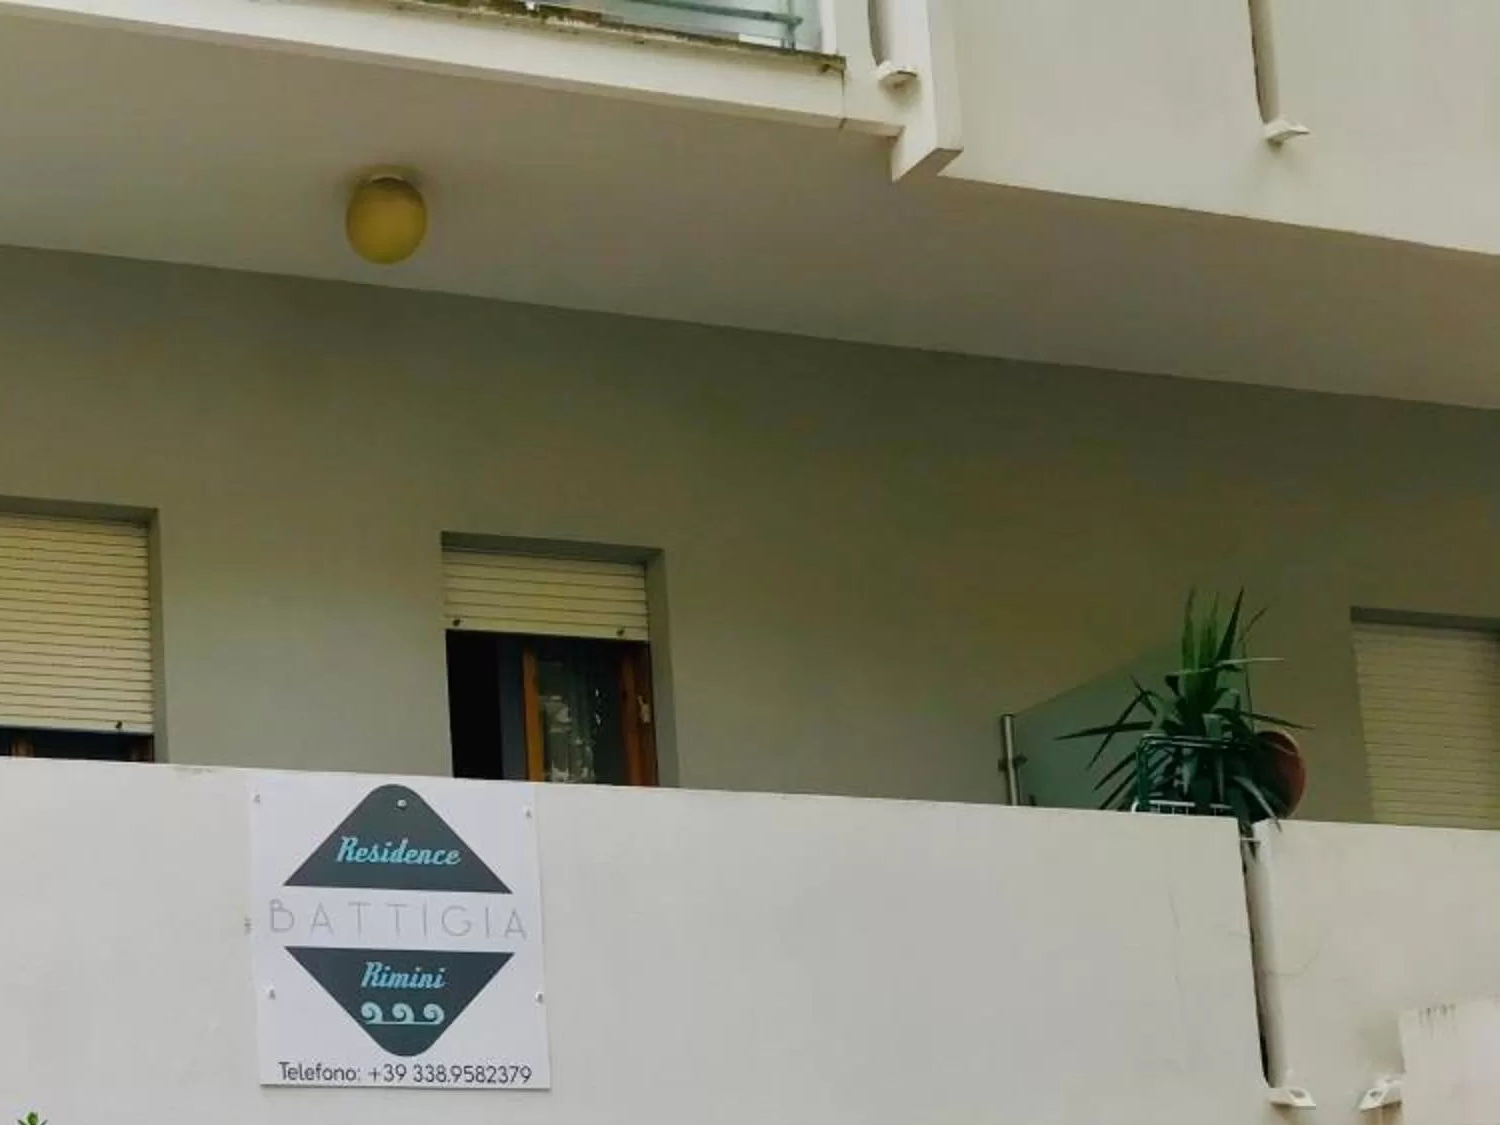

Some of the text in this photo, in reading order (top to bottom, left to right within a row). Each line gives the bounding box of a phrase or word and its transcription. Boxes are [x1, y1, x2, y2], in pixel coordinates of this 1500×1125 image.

[336, 836, 462, 865] Residence
[269, 899, 528, 941] BATTIGIA
[361, 961, 448, 989] Rimini
[278, 1061, 533, 1084] Telefono: +39 338.9582379
